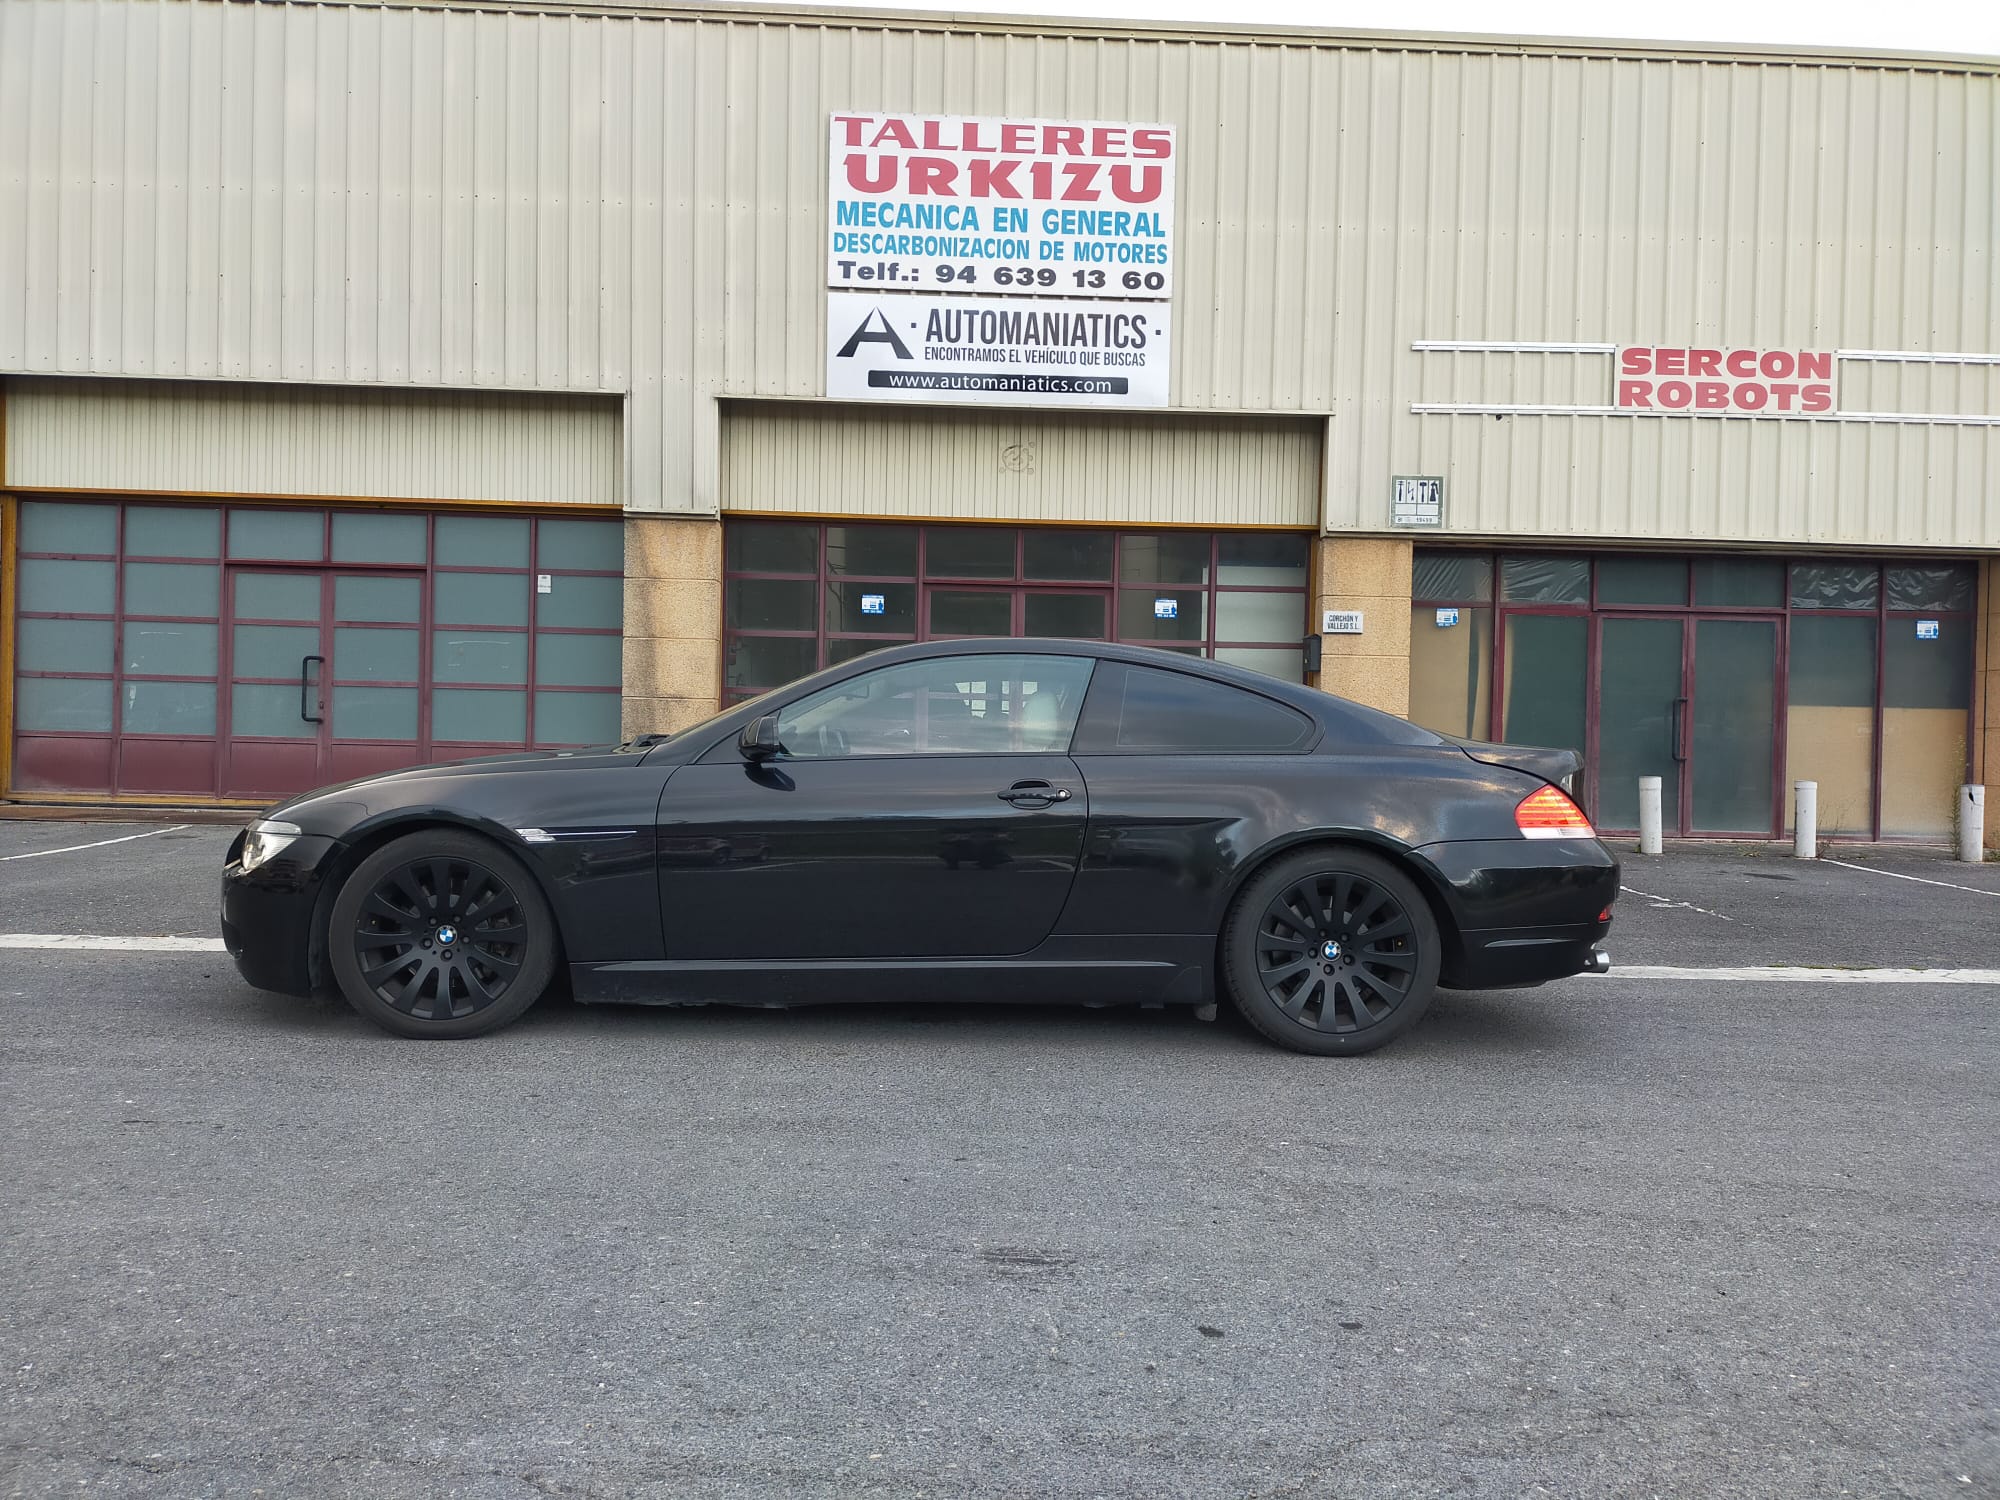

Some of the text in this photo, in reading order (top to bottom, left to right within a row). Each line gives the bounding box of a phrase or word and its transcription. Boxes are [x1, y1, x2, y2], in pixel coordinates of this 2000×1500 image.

[834, 116, 1172, 159] TALLERES
[843, 153, 1163, 204] URKIZU
[836, 200, 1166, 238] MECANICA EN GENERAL
[833, 232, 1168, 265] DESCARBONIZACION DE MOTORES
[837, 260, 1165, 291] Telf.: 94 639 13 60
[925, 308, 1147, 349] AUTOMANIATICS
[924, 346, 1146, 367] ENCONTRAMOS EL VEHÍCULO QUE BUSCAS
[1621, 347, 1832, 380] SERCON
[889, 374, 1112, 393] www.automaniatics.com
[1619, 379, 1832, 412] ROBOTS
[1327, 622, 1349, 630] VALLEJO
